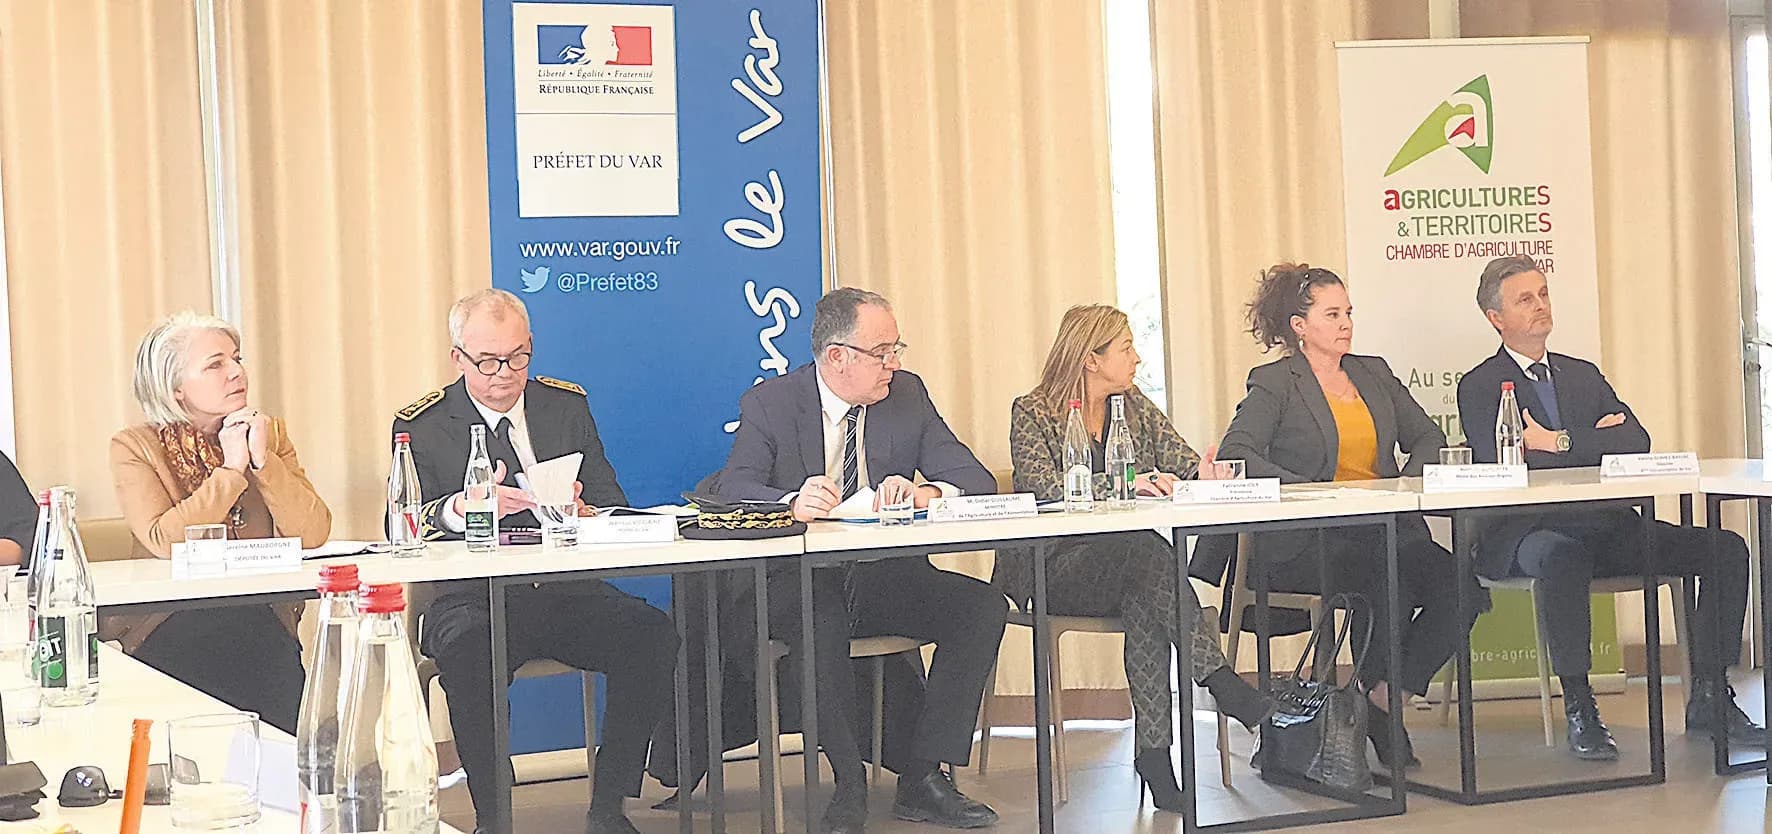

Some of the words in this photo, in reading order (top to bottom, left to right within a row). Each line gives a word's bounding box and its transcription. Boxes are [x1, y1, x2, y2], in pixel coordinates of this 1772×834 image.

[538, 69, 567, 78] Liberté
[577, 69, 605, 79] Égalité
[614, 70, 653, 79] Fraternité
[731, 9, 783, 143] Var
[539, 83, 600, 95] RÉPUBLIQUE
[603, 85, 654, 96] FRANÇAISE
[533, 152, 595, 169] PRÉFET
[600, 155, 624, 168] DU
[628, 155, 662, 168] VAR
[723, 170, 784, 249] le
[1397, 221, 1409, 238] &
[1411, 212, 1552, 237] TERRITOIRES
[520, 237, 681, 260] www.var.gouv.fr
[1386, 243, 1450, 260] CHAMBRE
[1454, 240, 1554, 258] D'AGRICULTURE
[557, 273, 658, 291] @Prefet83
[1408, 367, 1434, 388] Au
